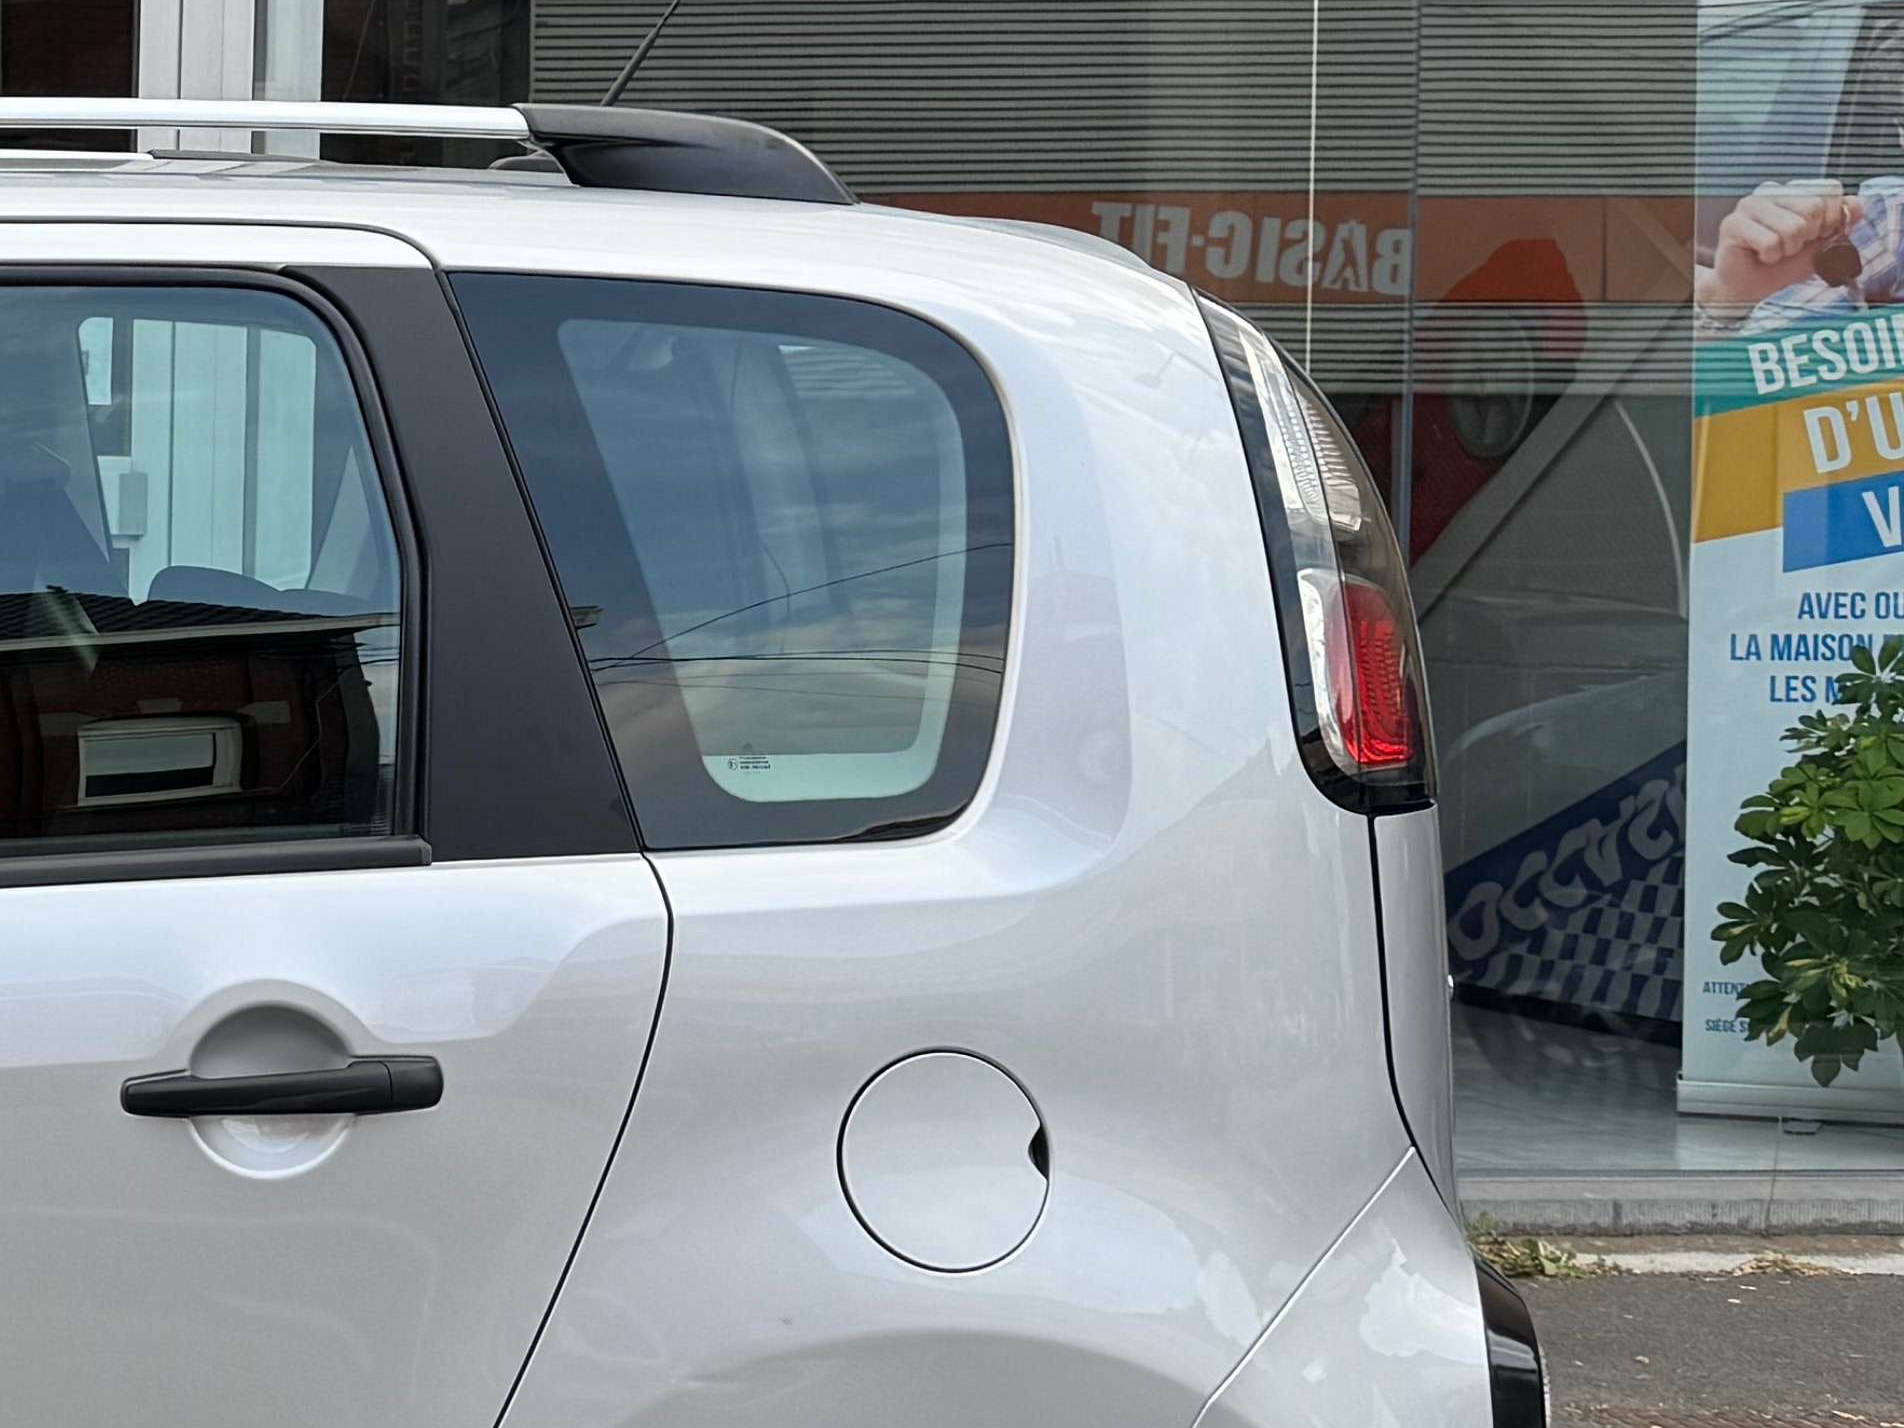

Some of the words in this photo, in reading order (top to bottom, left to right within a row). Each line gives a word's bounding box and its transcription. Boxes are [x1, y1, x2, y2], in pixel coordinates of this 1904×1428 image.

[1797, 592, 1867, 619] AVEC
[1730, 633, 1762, 661] LA
[1769, 675, 1817, 703] LES
